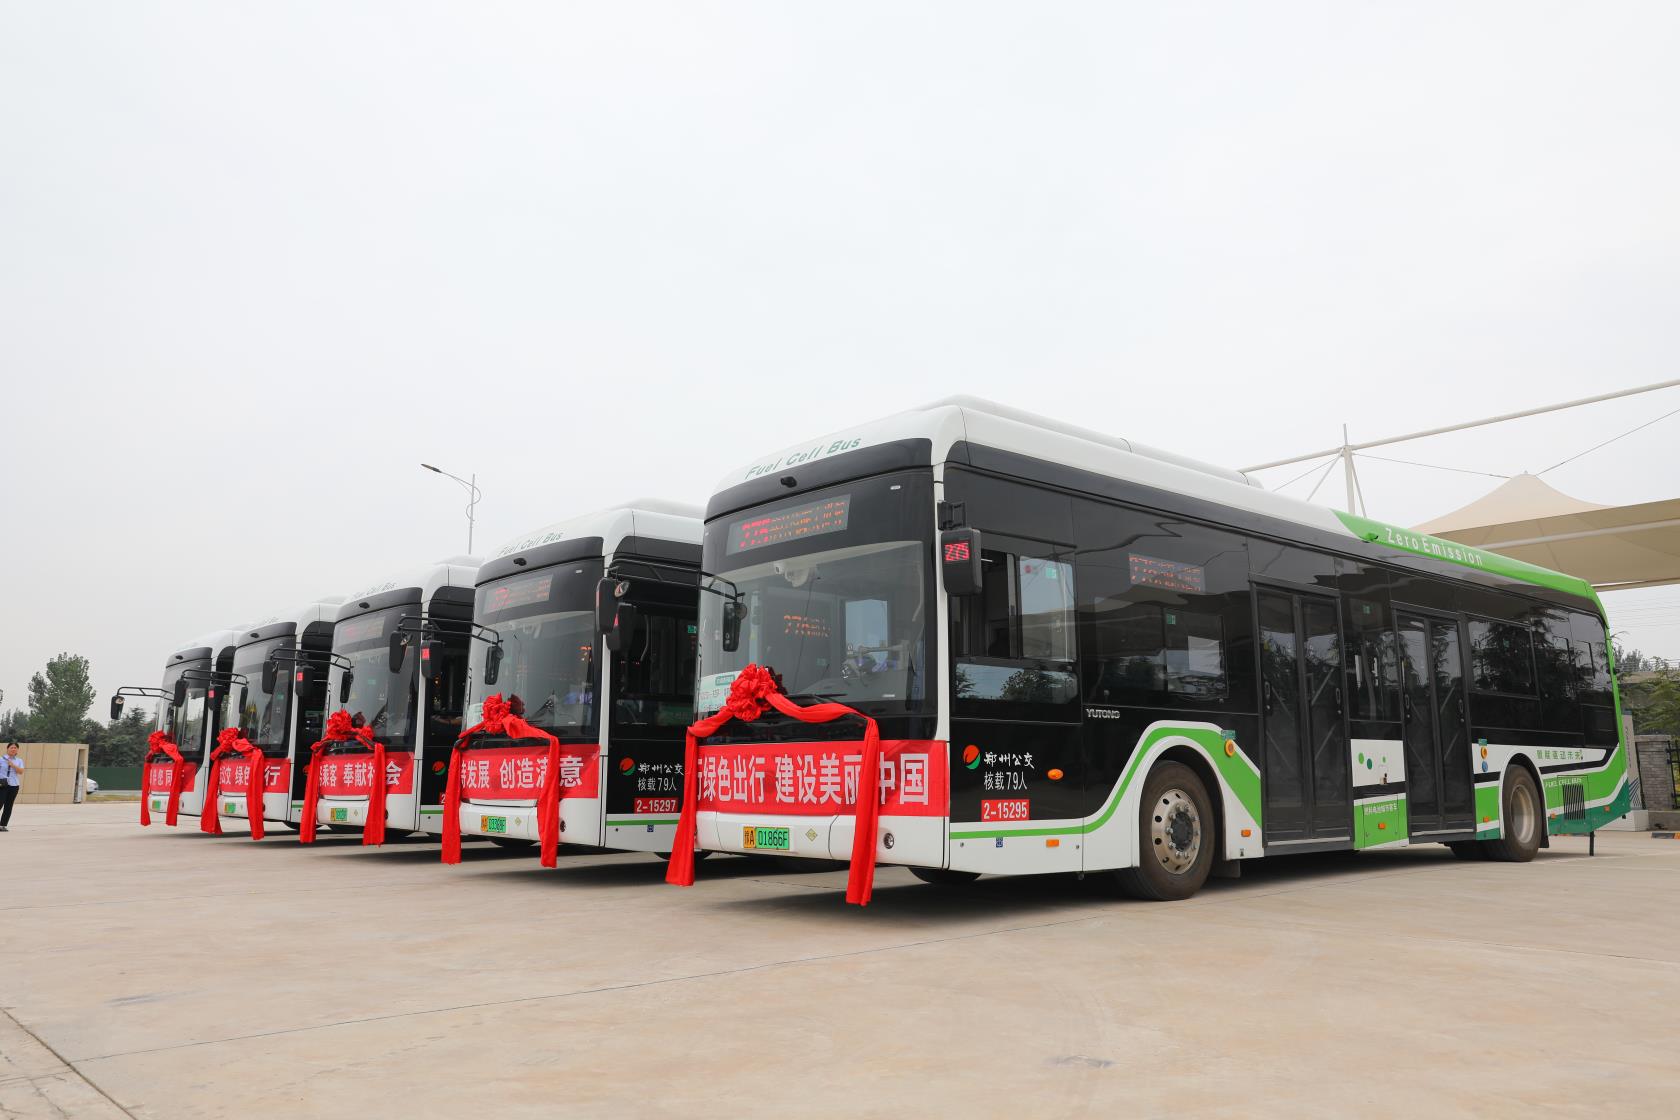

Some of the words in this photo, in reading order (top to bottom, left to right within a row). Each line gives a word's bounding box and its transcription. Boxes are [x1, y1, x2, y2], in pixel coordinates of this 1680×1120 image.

[745, 458, 783, 480] Fuel
[786, 445, 824, 466] Cell
[827, 438, 862, 455] Bus
[1385, 527, 1419, 550] Zero
[1421, 537, 1483, 567] Emission
[1086, 708, 1121, 719] YUTONG
[983, 751, 1035, 770] 郑州公交
[637, 777, 677, 792] 核载79人
[983, 771, 1028, 791] 核载79人
[636, 799, 677, 813] 2-15297
[983, 801, 1028, 820] 2-15295
